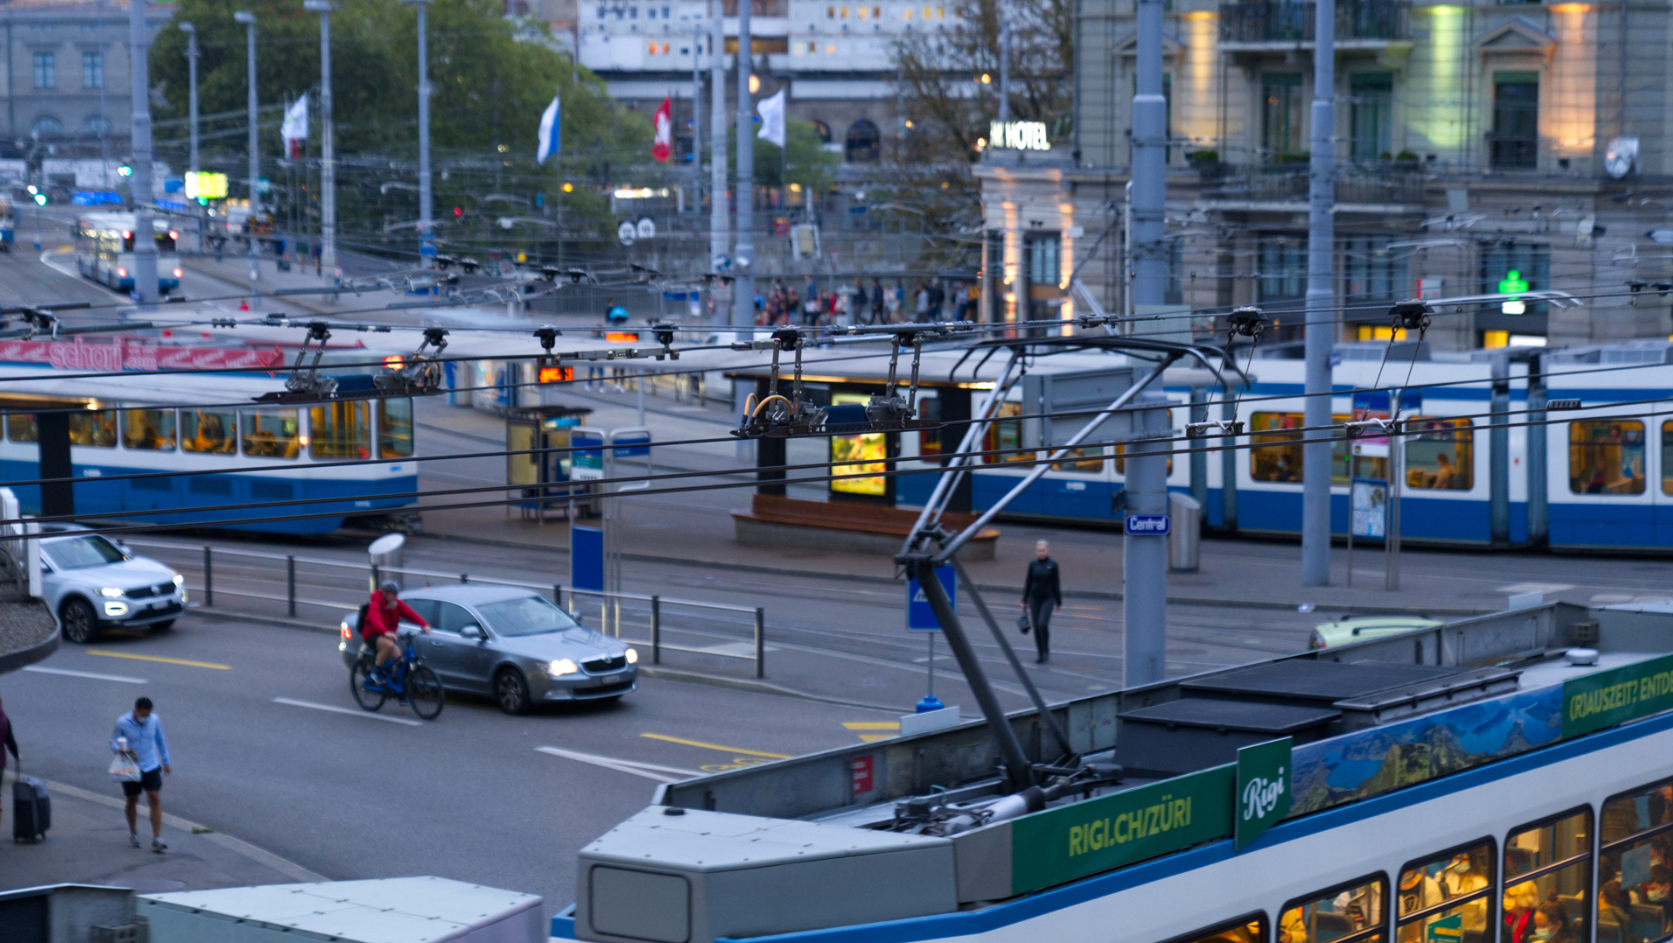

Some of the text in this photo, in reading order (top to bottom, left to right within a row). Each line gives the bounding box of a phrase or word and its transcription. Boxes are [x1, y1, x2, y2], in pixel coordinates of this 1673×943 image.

[1005, 120, 1051, 150] HOTEL
[49, 336, 123, 370] schori
[1130, 517, 1166, 530] Central
[1569, 680, 1639, 721] (R)AUSZEIT?
[1243, 766, 1285, 821] Rigi
[1069, 794, 1192, 857] RIGI.CH/ZÜRI
